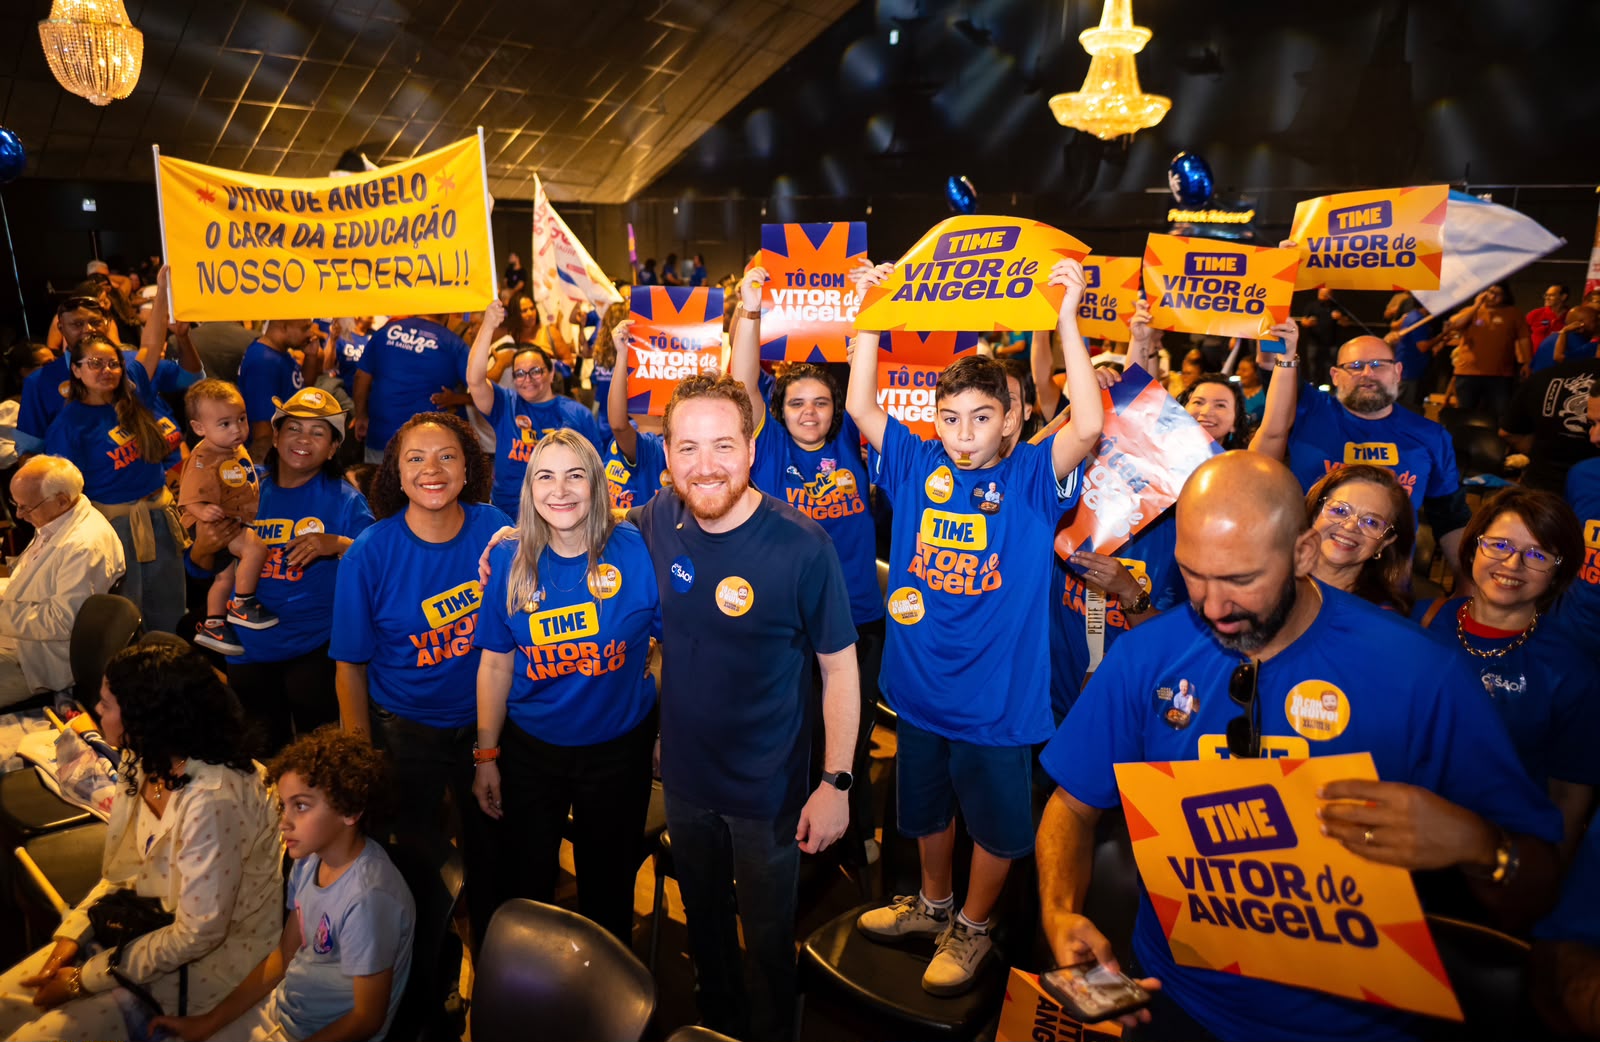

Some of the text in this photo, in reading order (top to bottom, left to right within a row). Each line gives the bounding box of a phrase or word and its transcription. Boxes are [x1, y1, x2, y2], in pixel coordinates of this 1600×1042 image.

[223, 172, 427, 213] VITOR DE ANGELO
[205, 203, 457, 250] O CARA DA EDUCAÇÃO
[1337, 207, 1382, 230] TIME
[948, 230, 1007, 254] TIME
[1307, 233, 1417, 253] VITOR de
[196, 249, 470, 295] NOSSO FEDERAL!!
[904, 257, 1039, 282] VITOR de
[1193, 256, 1238, 272] TIME
[785, 267, 844, 288] TÔ COM
[1162, 274, 1267, 299] VITOR de
[770, 289, 861, 306] VITOR de
[1100, 293, 1118, 308] de
[387, 324, 438, 353] Geiza
[649, 331, 702, 351] TÔ COM
[636, 350, 718, 368] VITOR de
[888, 365, 910, 387] TÔ
[107, 440, 138, 461] VIT
[1096, 432, 1118, 456] Ô
[1353, 447, 1390, 460] TIME
[806, 475, 831, 495] TIME
[1398, 470, 1417, 486] de
[787, 498, 865, 520] NGeLO
[933, 518, 975, 543] TIME
[916, 532, 979, 577] ITOR
[432, 587, 479, 619] TIME
[539, 611, 587, 637] TIME
[1087, 607, 1103, 635] PETITE
[416, 634, 475, 667] ANG
[519, 639, 627, 665] VITOR de
[1196, 798, 1278, 844] TIME
[1167, 855, 1364, 907] VITOR de
